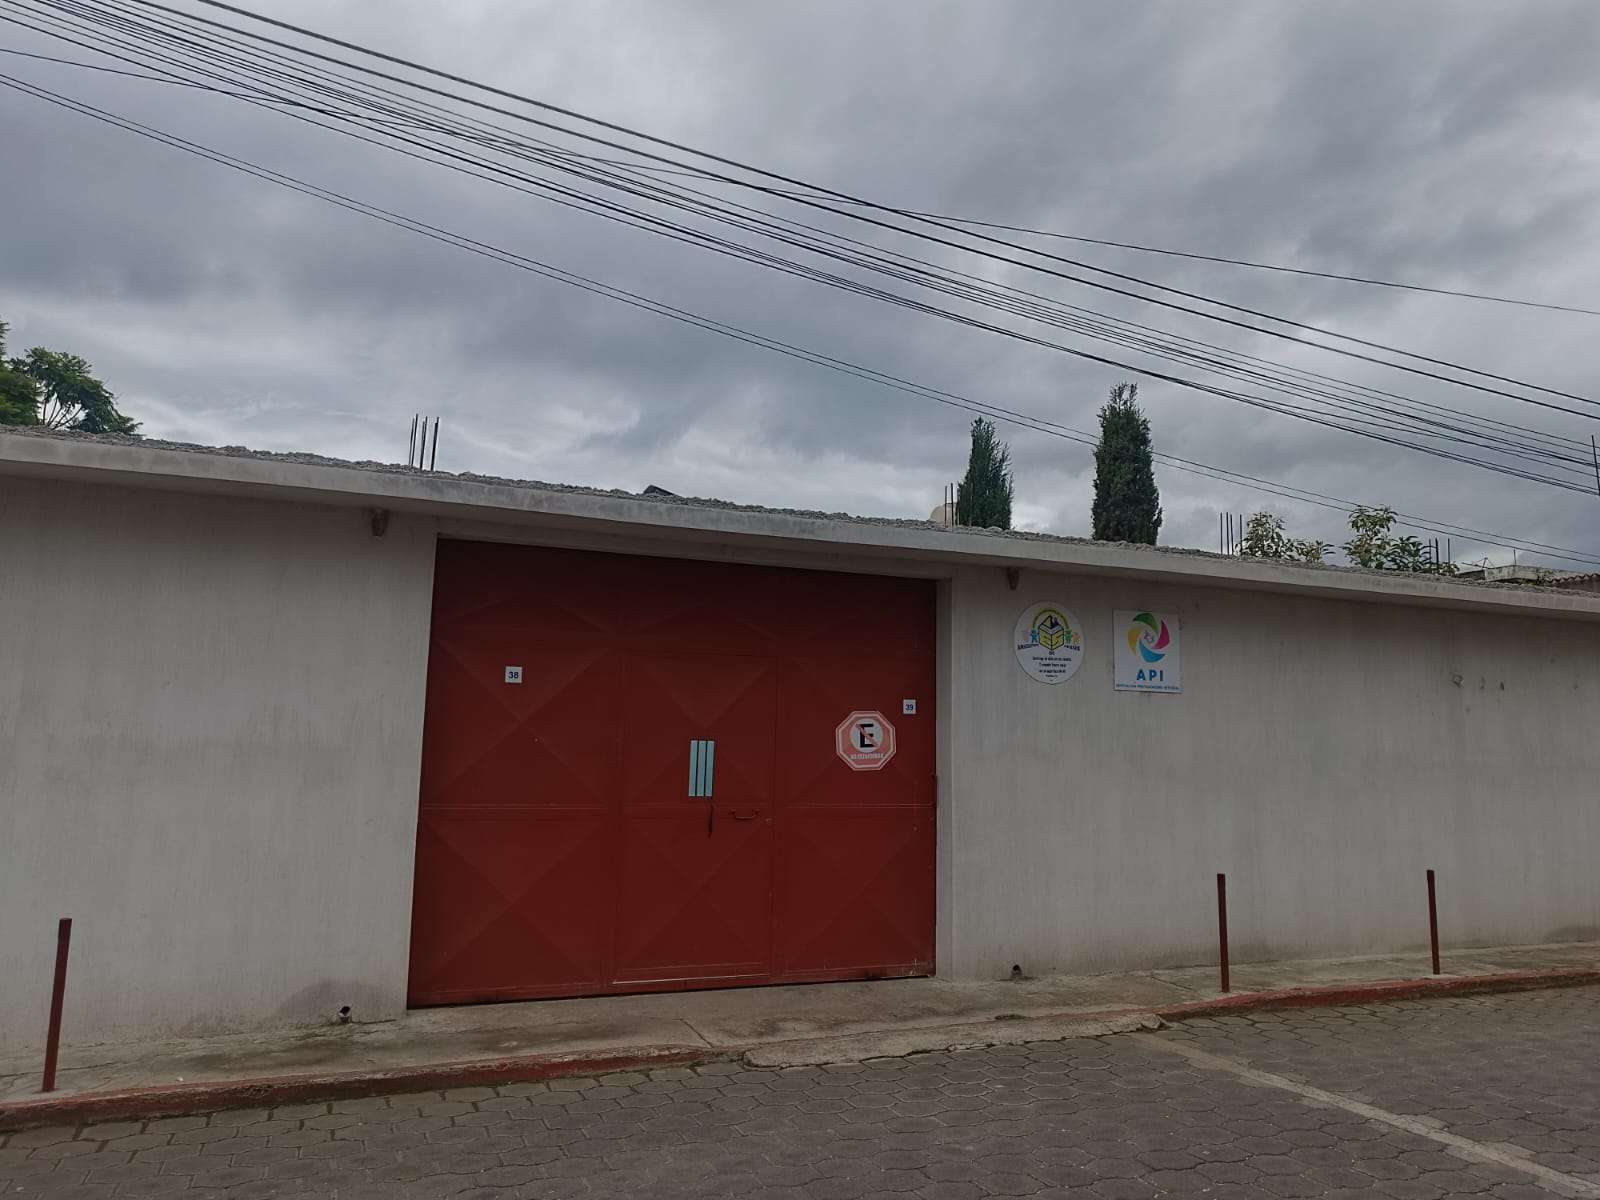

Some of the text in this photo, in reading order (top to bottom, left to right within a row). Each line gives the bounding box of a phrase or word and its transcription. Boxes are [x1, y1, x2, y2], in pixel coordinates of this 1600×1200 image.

[508, 671, 519, 679] 38
[1136, 669, 1163, 681] API
[860, 723, 875, 748] E
